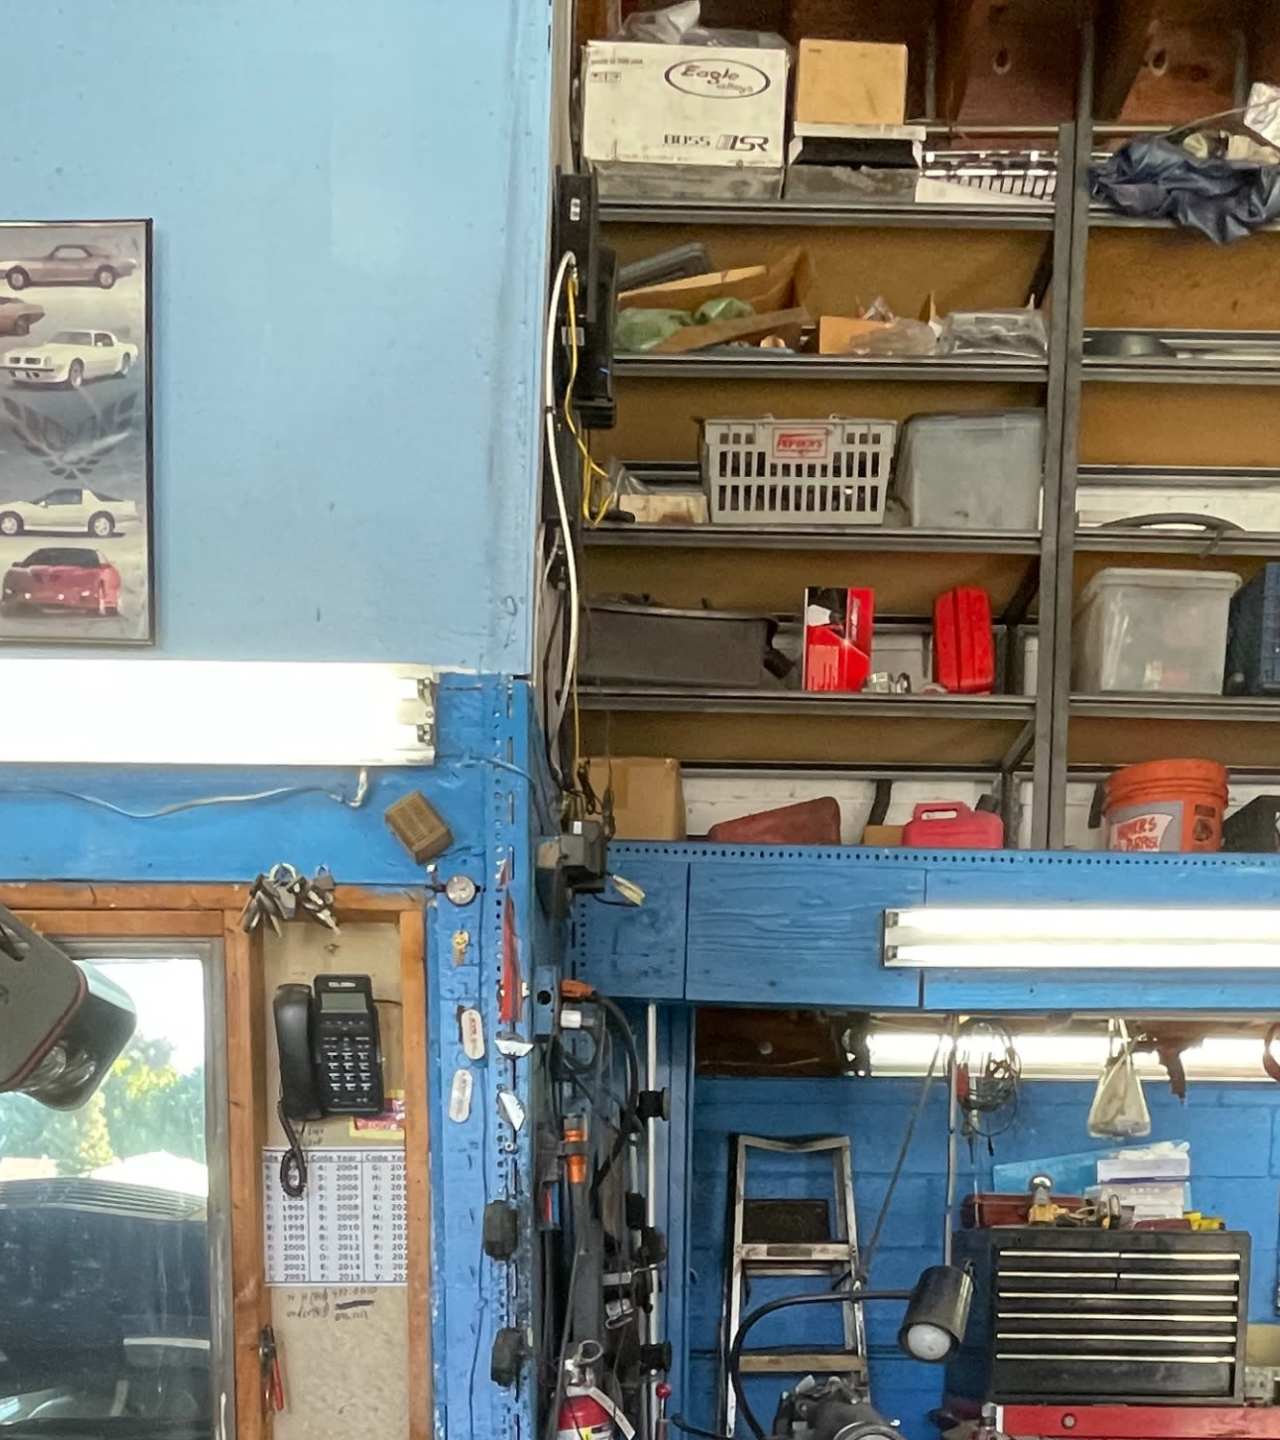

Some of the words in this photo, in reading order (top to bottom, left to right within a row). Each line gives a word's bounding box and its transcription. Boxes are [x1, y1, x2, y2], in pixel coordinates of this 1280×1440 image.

[680, 64, 740, 85] Eagle
[337, 1193, 359, 1201] 2007
[337, 1223, 359, 1231] 2010
[338, 1233, 360, 1241] 2011
[284, 1253, 305, 1261] 2001
